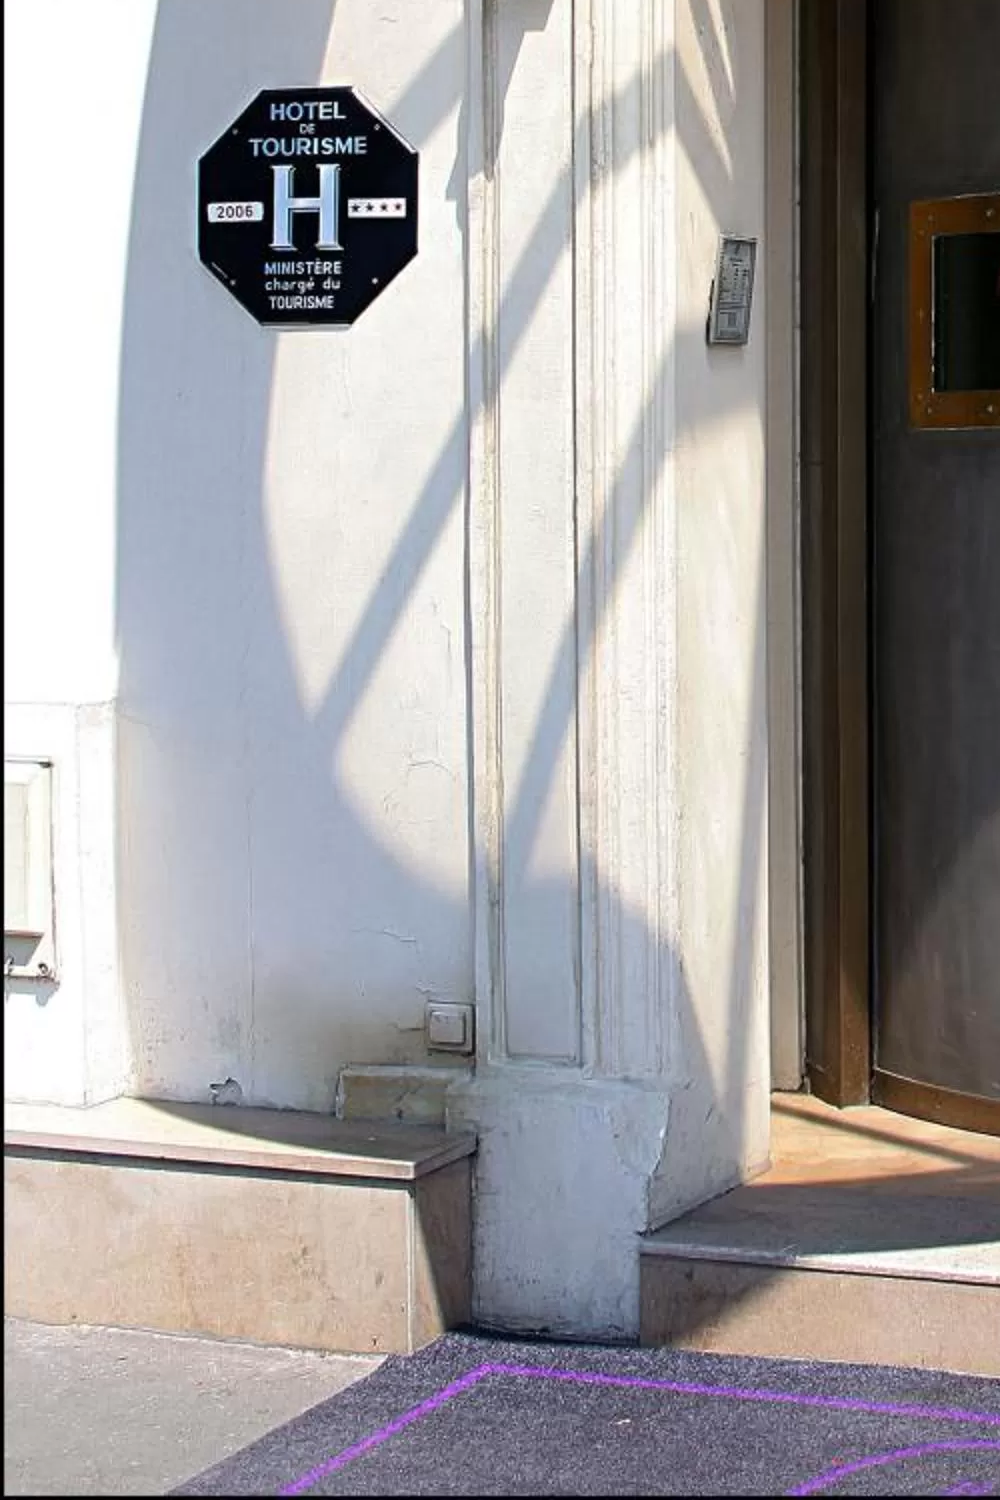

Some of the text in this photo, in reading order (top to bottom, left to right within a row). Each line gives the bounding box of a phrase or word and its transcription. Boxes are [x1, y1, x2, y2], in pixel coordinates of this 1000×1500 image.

[270, 101, 347, 121] HOTEL
[299, 123, 316, 135] DE
[248, 136, 368, 157] TOURISME
[216, 204, 254, 219] 2006
[268, 163, 344, 251] H
[322, 276, 341, 291] du
[268, 295, 335, 310] TOURISME
